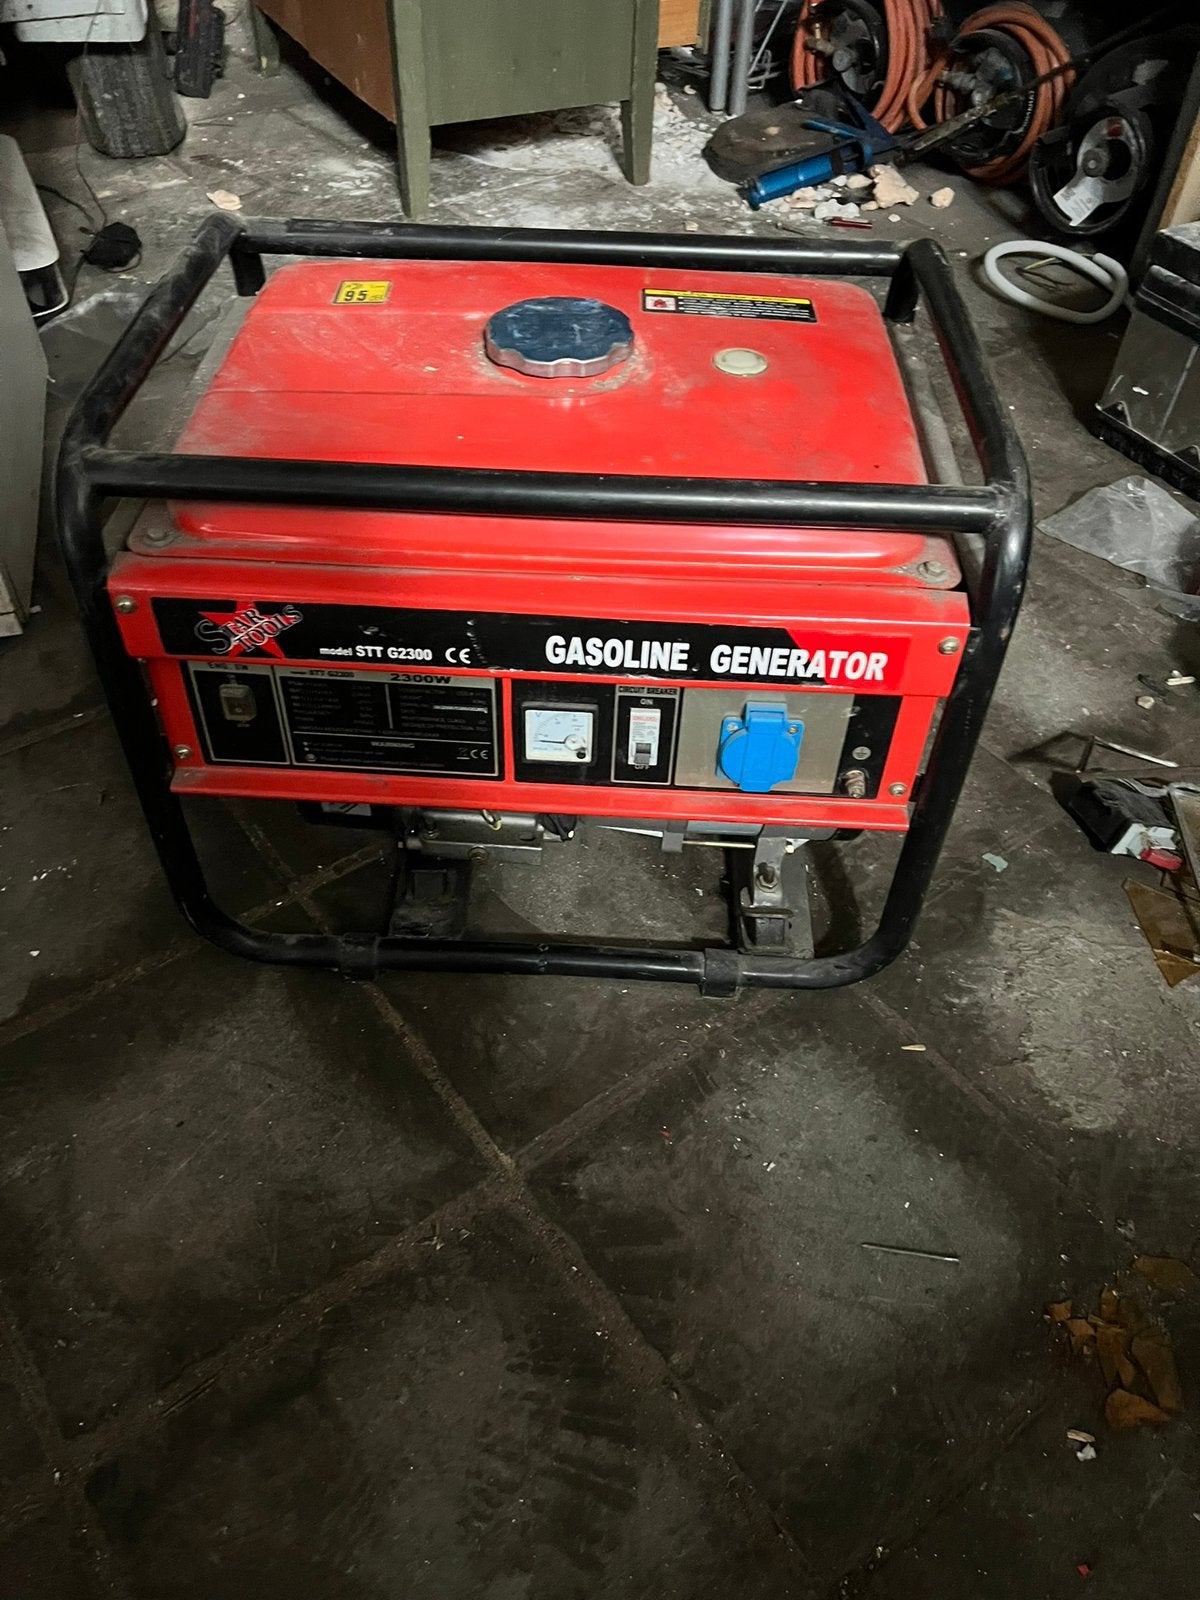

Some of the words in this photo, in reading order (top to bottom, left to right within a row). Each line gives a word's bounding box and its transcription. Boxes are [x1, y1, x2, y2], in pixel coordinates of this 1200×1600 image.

[344, 290, 368, 301] 95
[194, 608, 265, 654] STAR
[239, 605, 303, 652] TOOLS
[320, 647, 353, 656] model
[355, 646, 383, 658] STT
[387, 647, 433, 661] G2300
[545, 635, 690, 671] GASOLINE
[709, 644, 888, 681] GENERATOR
[390, 672, 452, 684] 2300W
